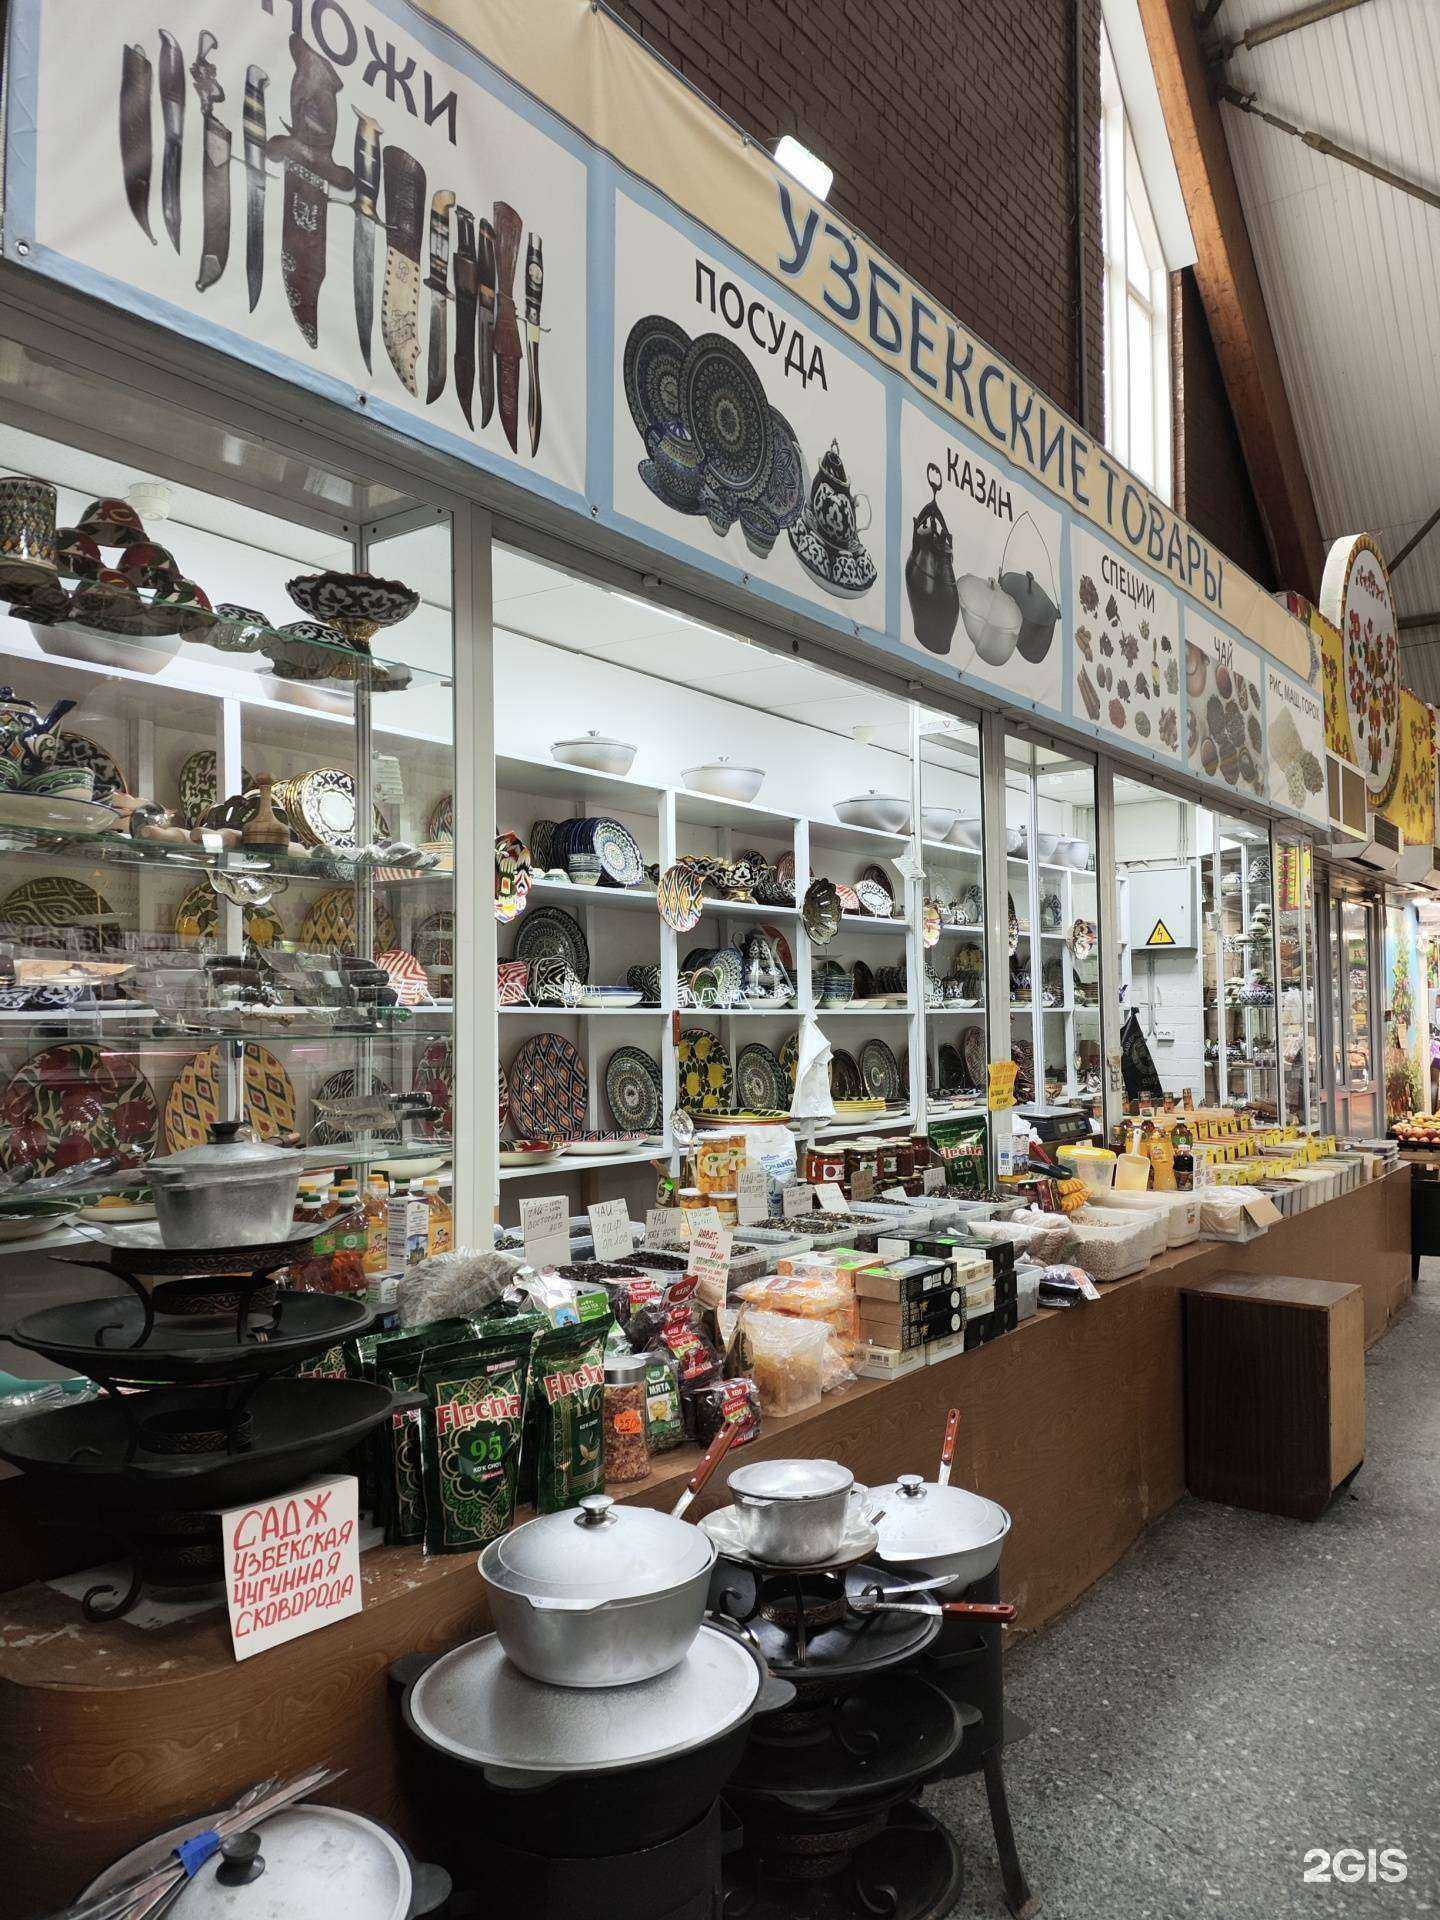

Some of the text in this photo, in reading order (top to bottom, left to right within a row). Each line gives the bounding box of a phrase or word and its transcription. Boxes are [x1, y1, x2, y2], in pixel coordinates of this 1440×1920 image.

[695, 258, 828, 391] ПОСУДА
[776, 181, 1223, 609] УЗБЕКСКИЕ ТОВАРЫ
[946, 448, 1014, 522] КАЗАН
[1101, 554, 1155, 613] СПЕЦИИ
[1213, 636, 1233, 671] ЧАЙ
[435, 1392, 523, 1436] Flecha
[648, 1381, 671, 1395] МЯТА
[470, 1431, 503, 1465] 95
[232, 1490, 332, 1551] САДЖ
[232, 1519, 354, 1581] УЗБЕКСКАЯ
[234, 1551, 341, 1609] ЧУГУННАЯ
[234, 1573, 354, 1639] СКОВОРОДА
